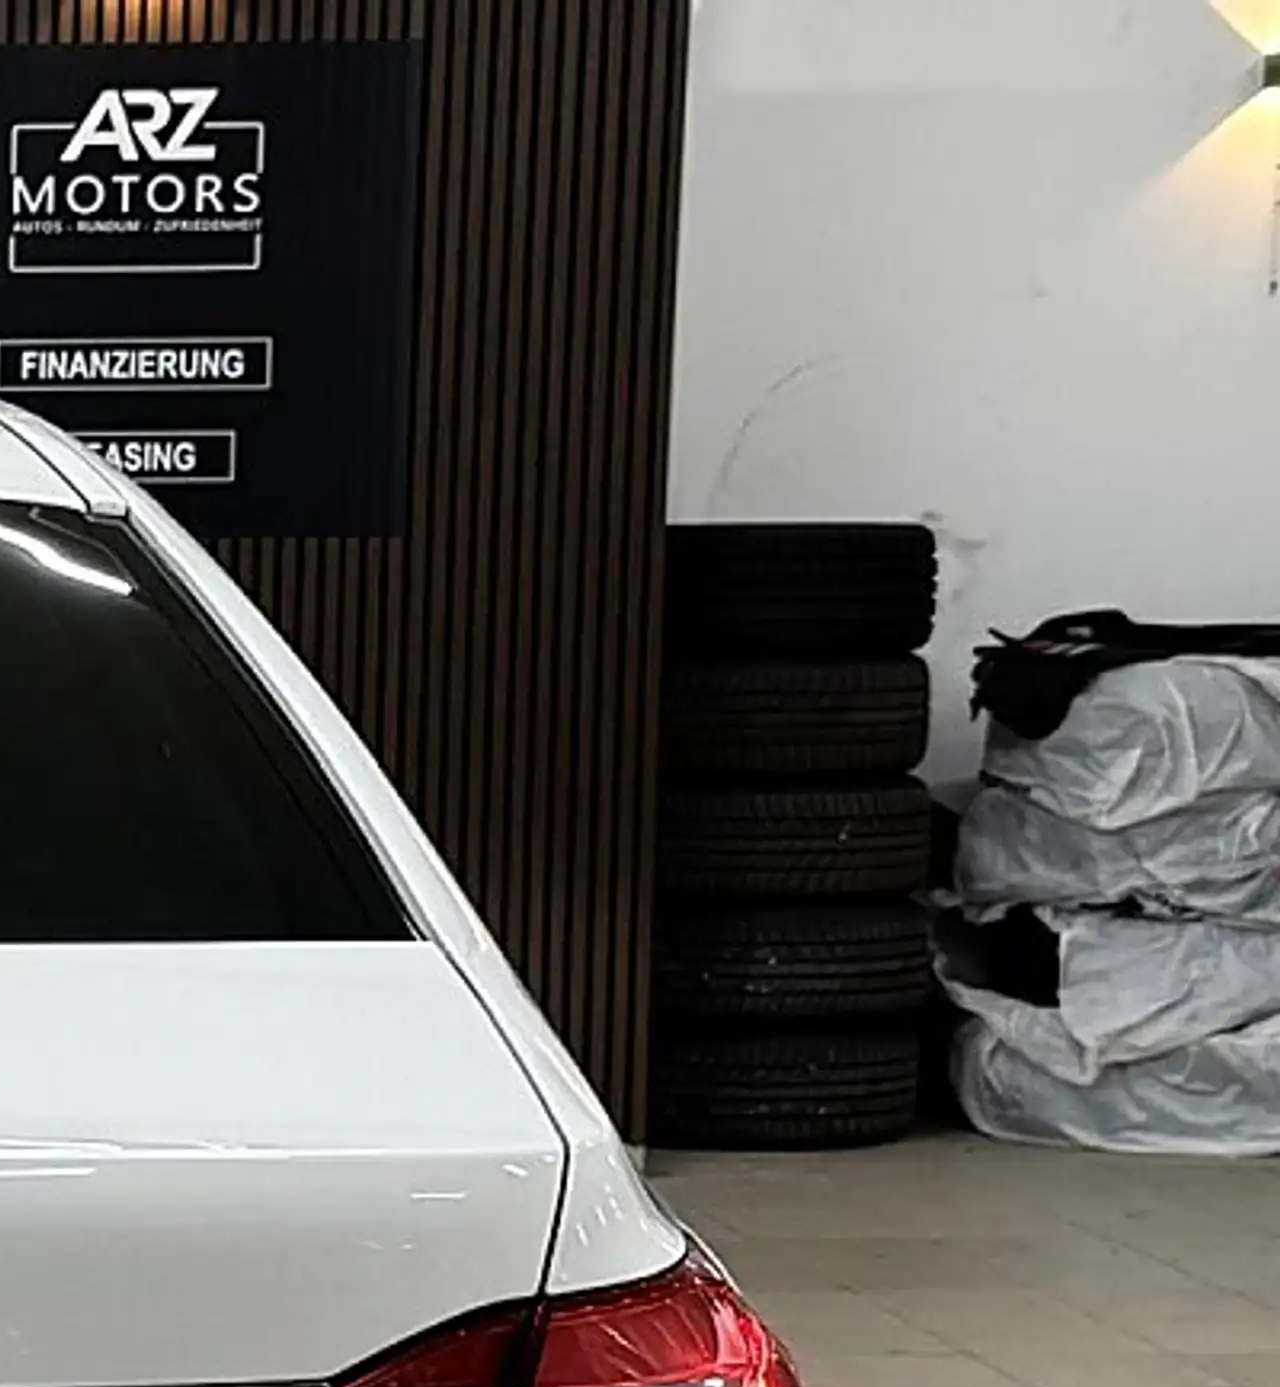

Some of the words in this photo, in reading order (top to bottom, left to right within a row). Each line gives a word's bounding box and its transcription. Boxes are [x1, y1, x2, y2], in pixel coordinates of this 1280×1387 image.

[59, 87, 220, 162] ARZ
[12, 172, 261, 215] MOTORS
[13, 219, 63, 235] AUTOS
[76, 219, 139, 233] RUNDUM
[153, 217, 263, 234] ZUFRIEDENHEIT
[20, 348, 245, 380] FINANZIERUNG
